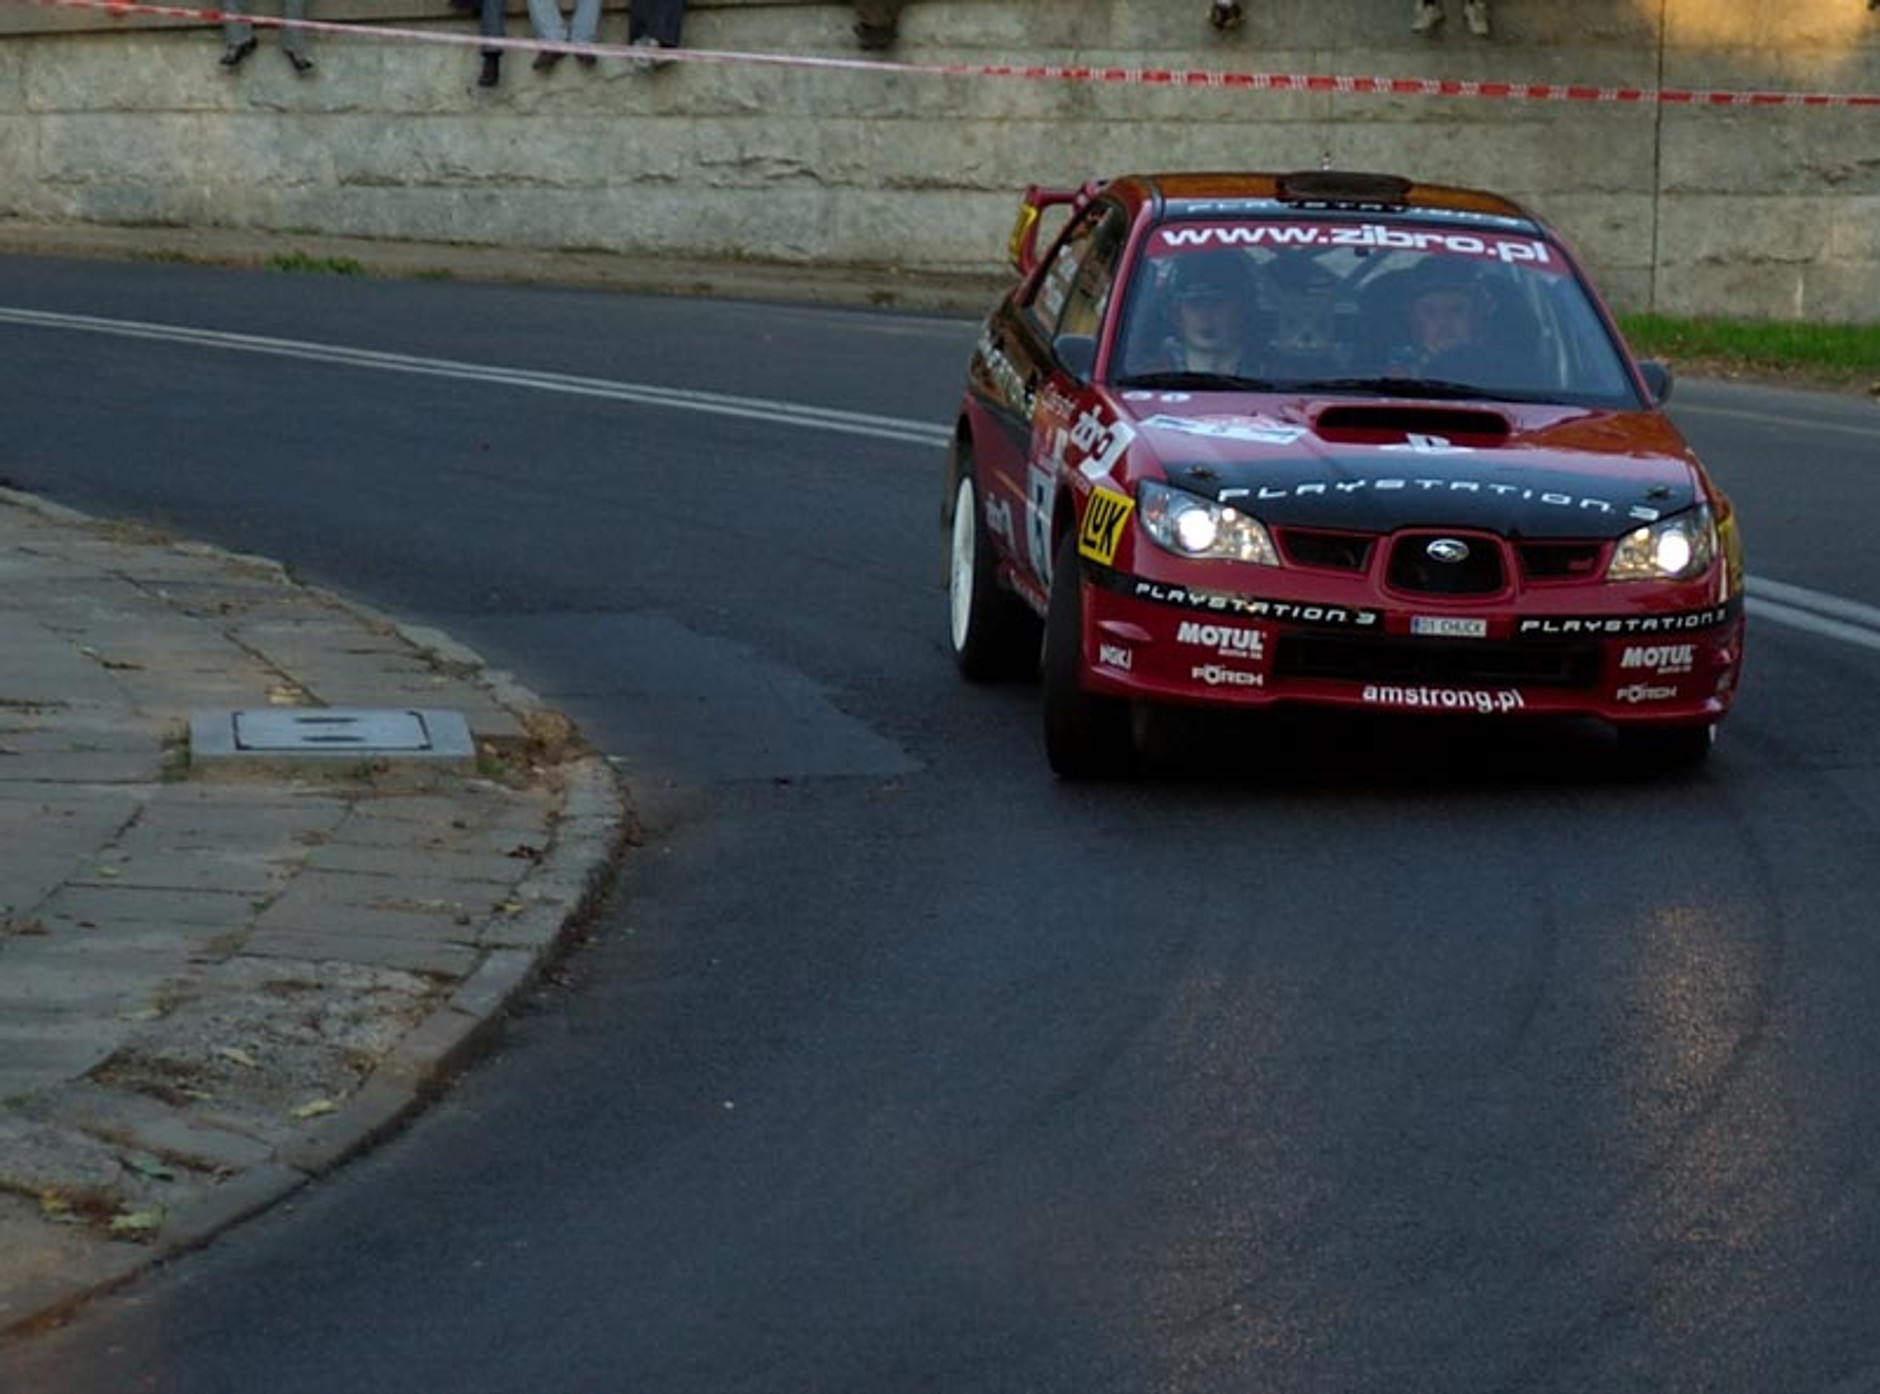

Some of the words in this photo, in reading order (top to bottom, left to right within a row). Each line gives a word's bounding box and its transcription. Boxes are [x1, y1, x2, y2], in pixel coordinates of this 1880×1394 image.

[1161, 224, 1549, 263] www.zibro.pl
[1218, 479, 1612, 512] PLAYSTATION
[1629, 505, 1660, 521] 3
[1135, 582, 1346, 622] PLAYSTATION
[1355, 613, 1377, 625] 3
[1177, 620, 1264, 651] MOTUL
[1520, 610, 1714, 633] PLAYSTATION
[1620, 644, 1694, 669] MOTUL
[1362, 685, 1525, 713] amstrong.pl
